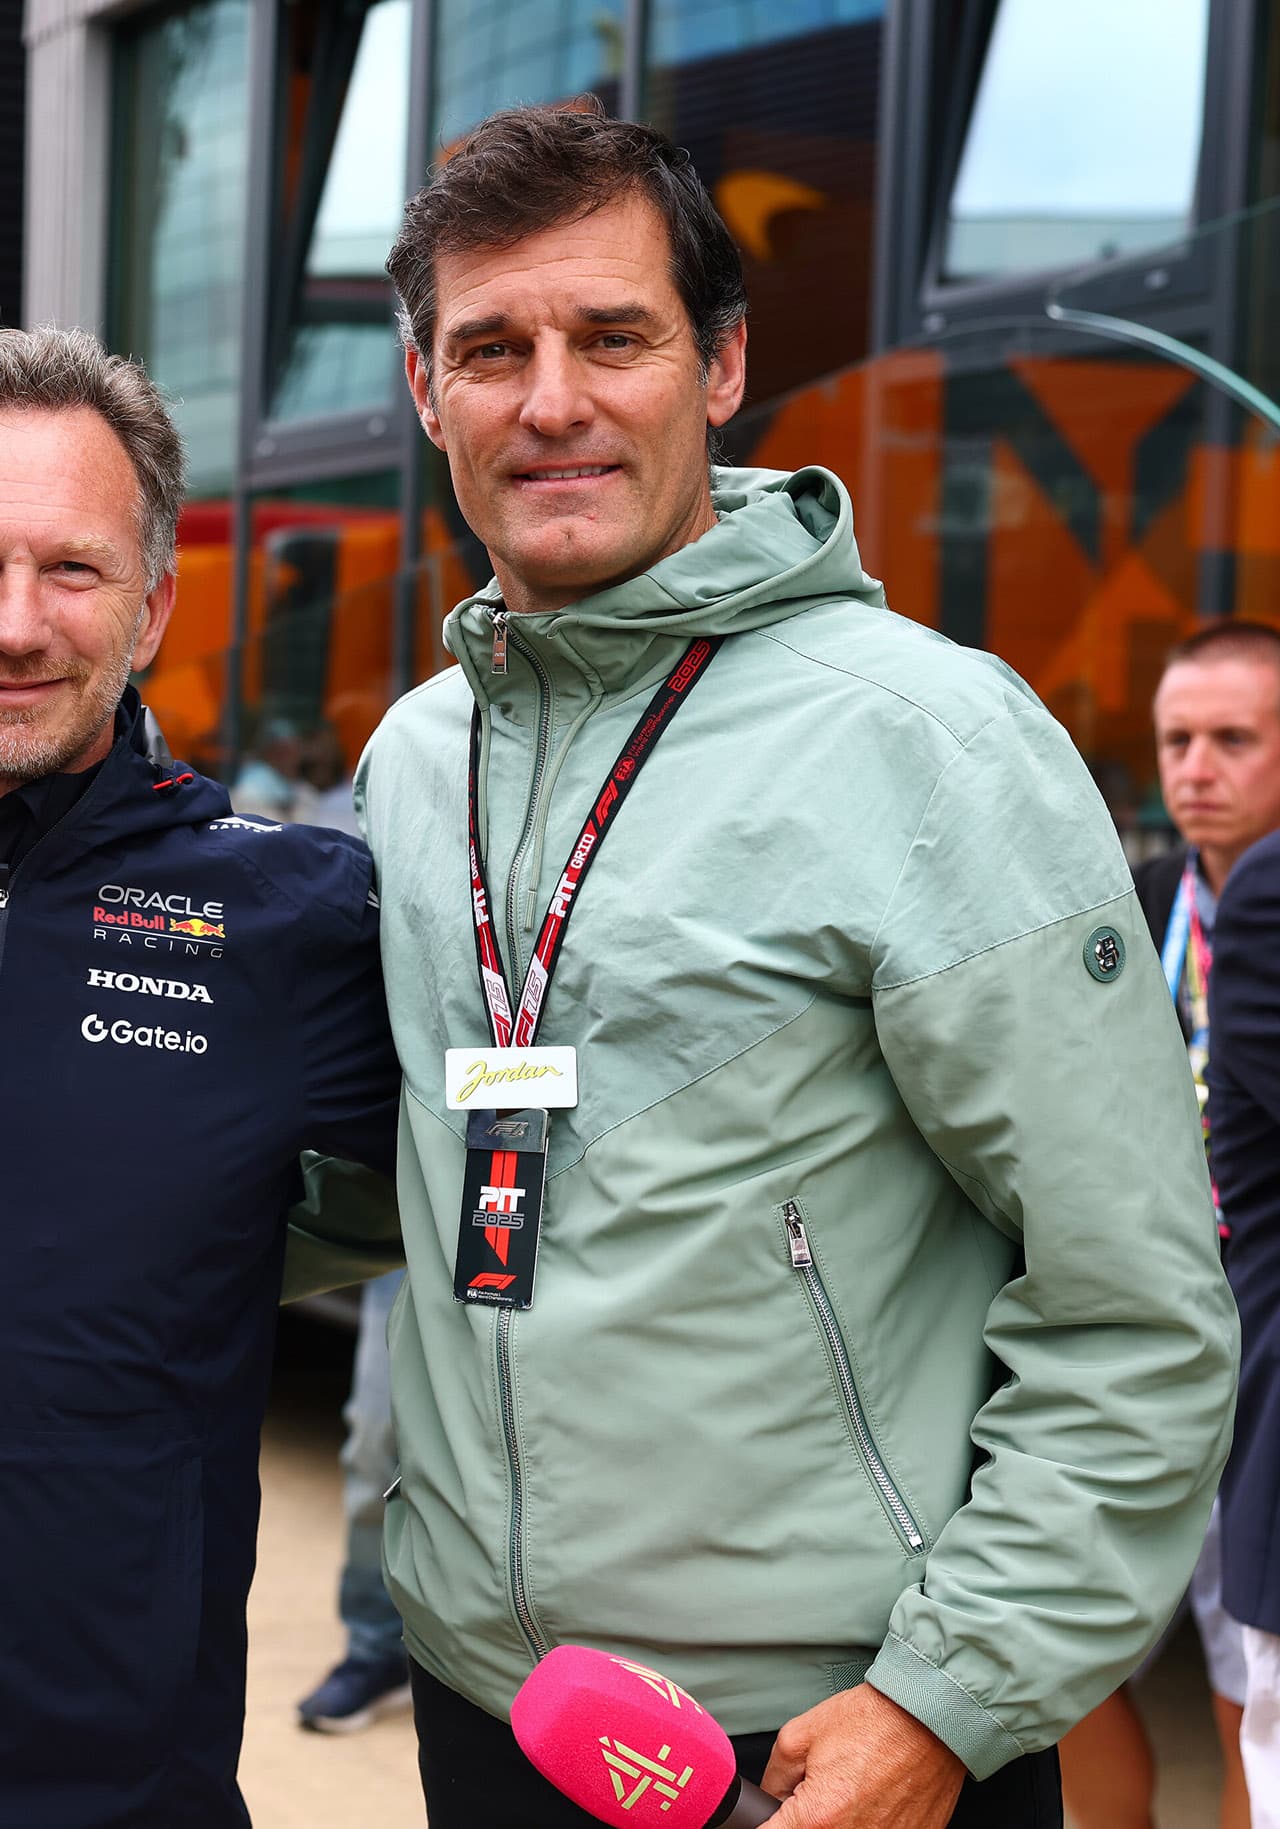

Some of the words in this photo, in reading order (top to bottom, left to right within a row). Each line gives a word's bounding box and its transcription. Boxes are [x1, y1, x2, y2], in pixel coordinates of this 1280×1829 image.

[667, 640, 711, 693] 2025
[548, 872, 577, 918] PIT
[570, 833, 596, 869] GRID
[98, 884, 224, 919] ORACLE
[473, 888, 490, 927] PIT
[93, 928, 224, 958] RACING
[86, 968, 214, 1004] HONDA
[110, 1020, 208, 1054] Gate.io
[456, 1060, 564, 1103] Jordan
[478, 1185, 526, 1213] PIT
[472, 1209, 525, 1230] 2025
